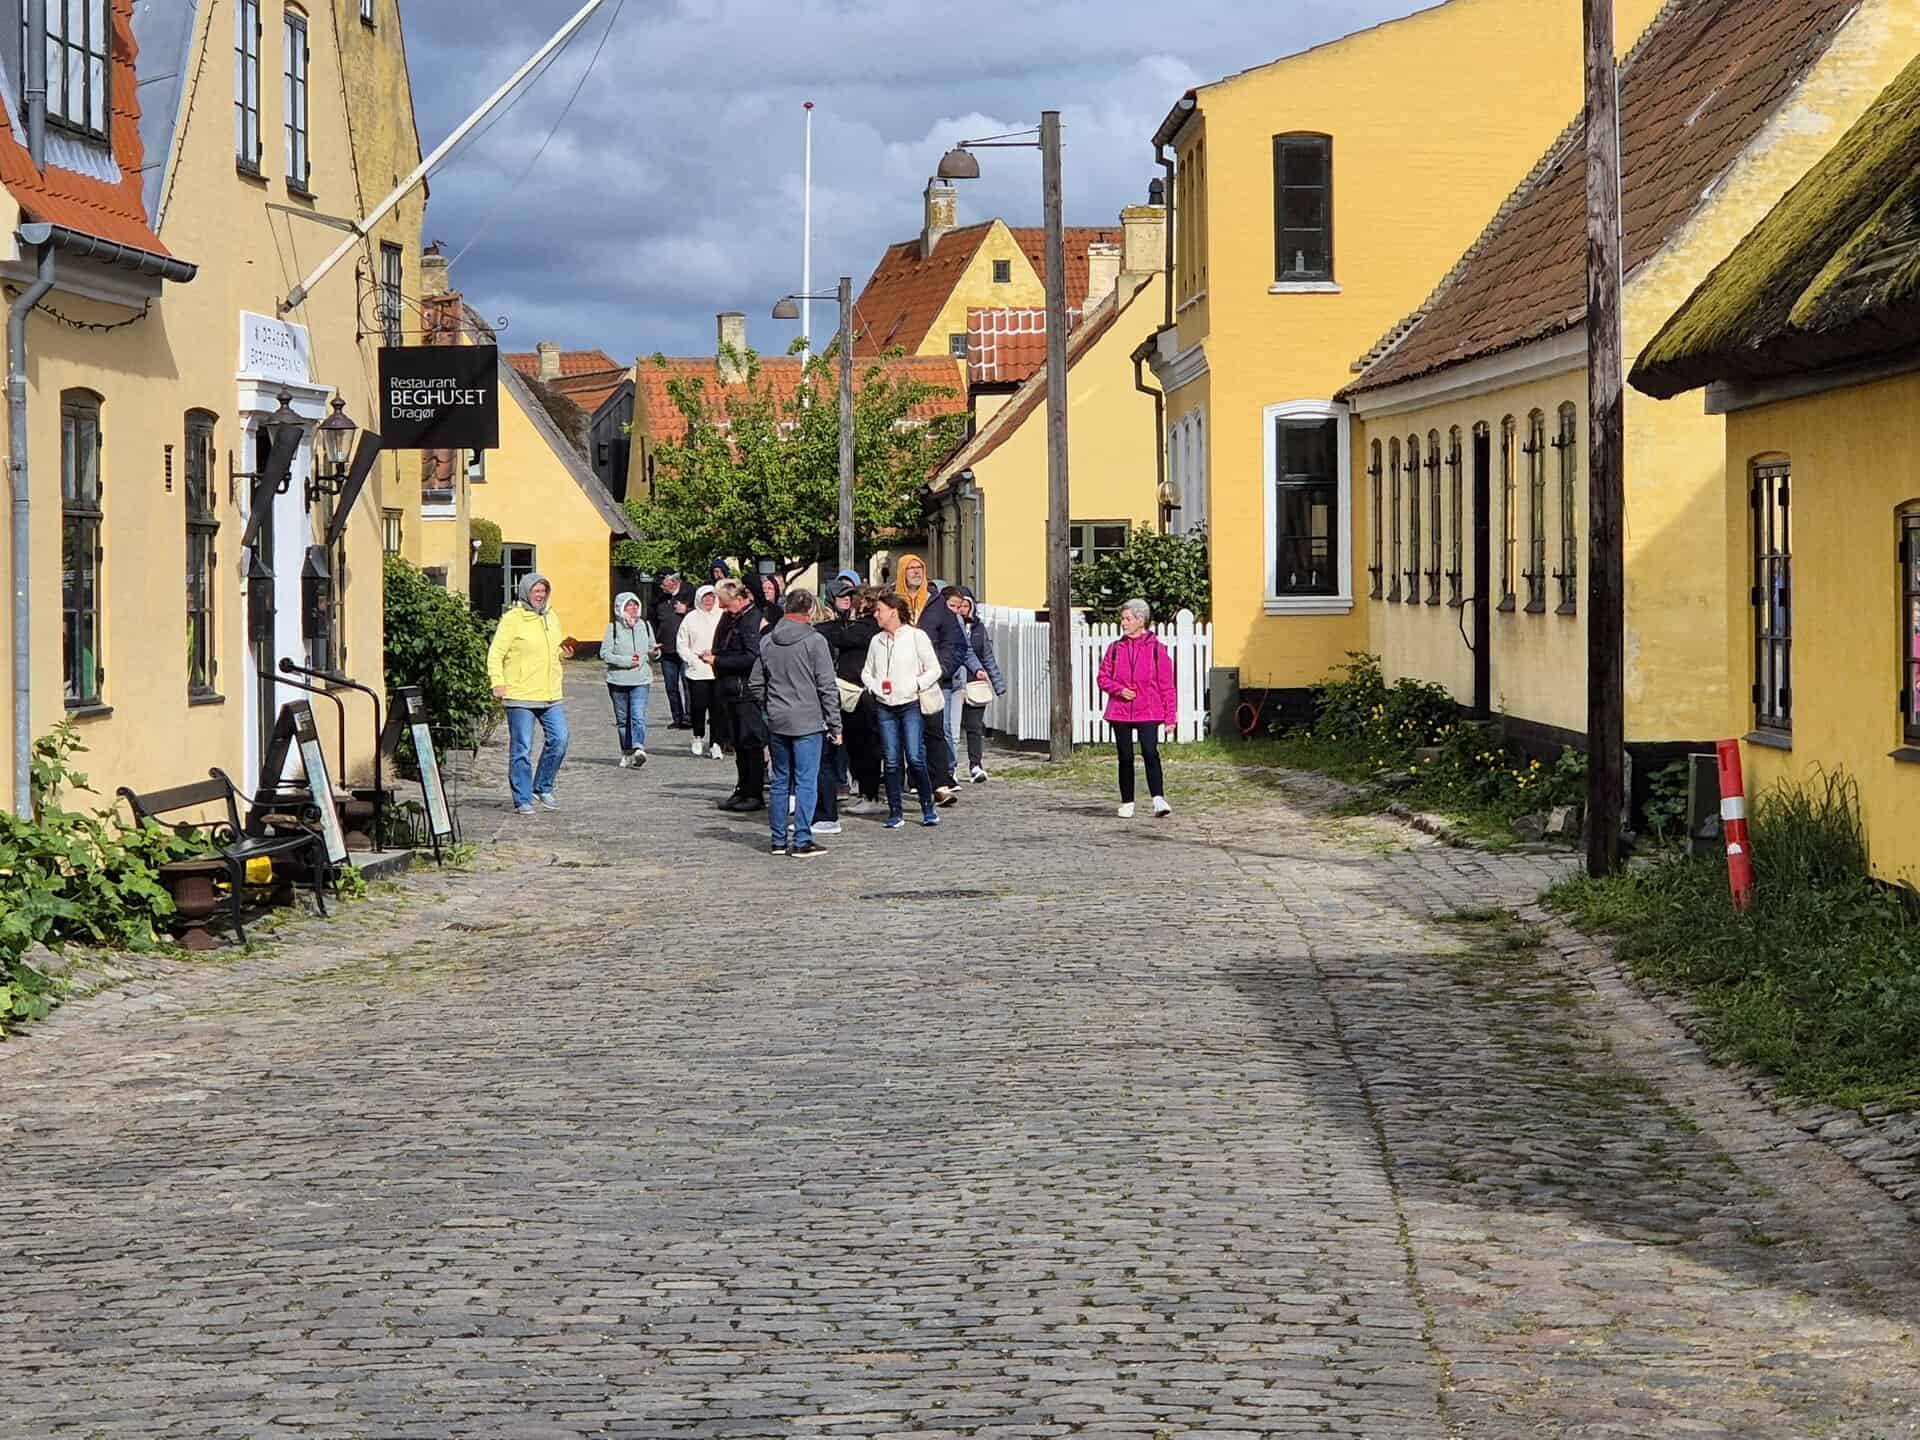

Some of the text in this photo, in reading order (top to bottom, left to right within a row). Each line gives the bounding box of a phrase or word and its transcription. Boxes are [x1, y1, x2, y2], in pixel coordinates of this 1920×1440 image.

[391, 377, 457, 389] Restaurant
[391, 389, 486, 405] BEGHUSET
[391, 406, 435, 421] Dragør
